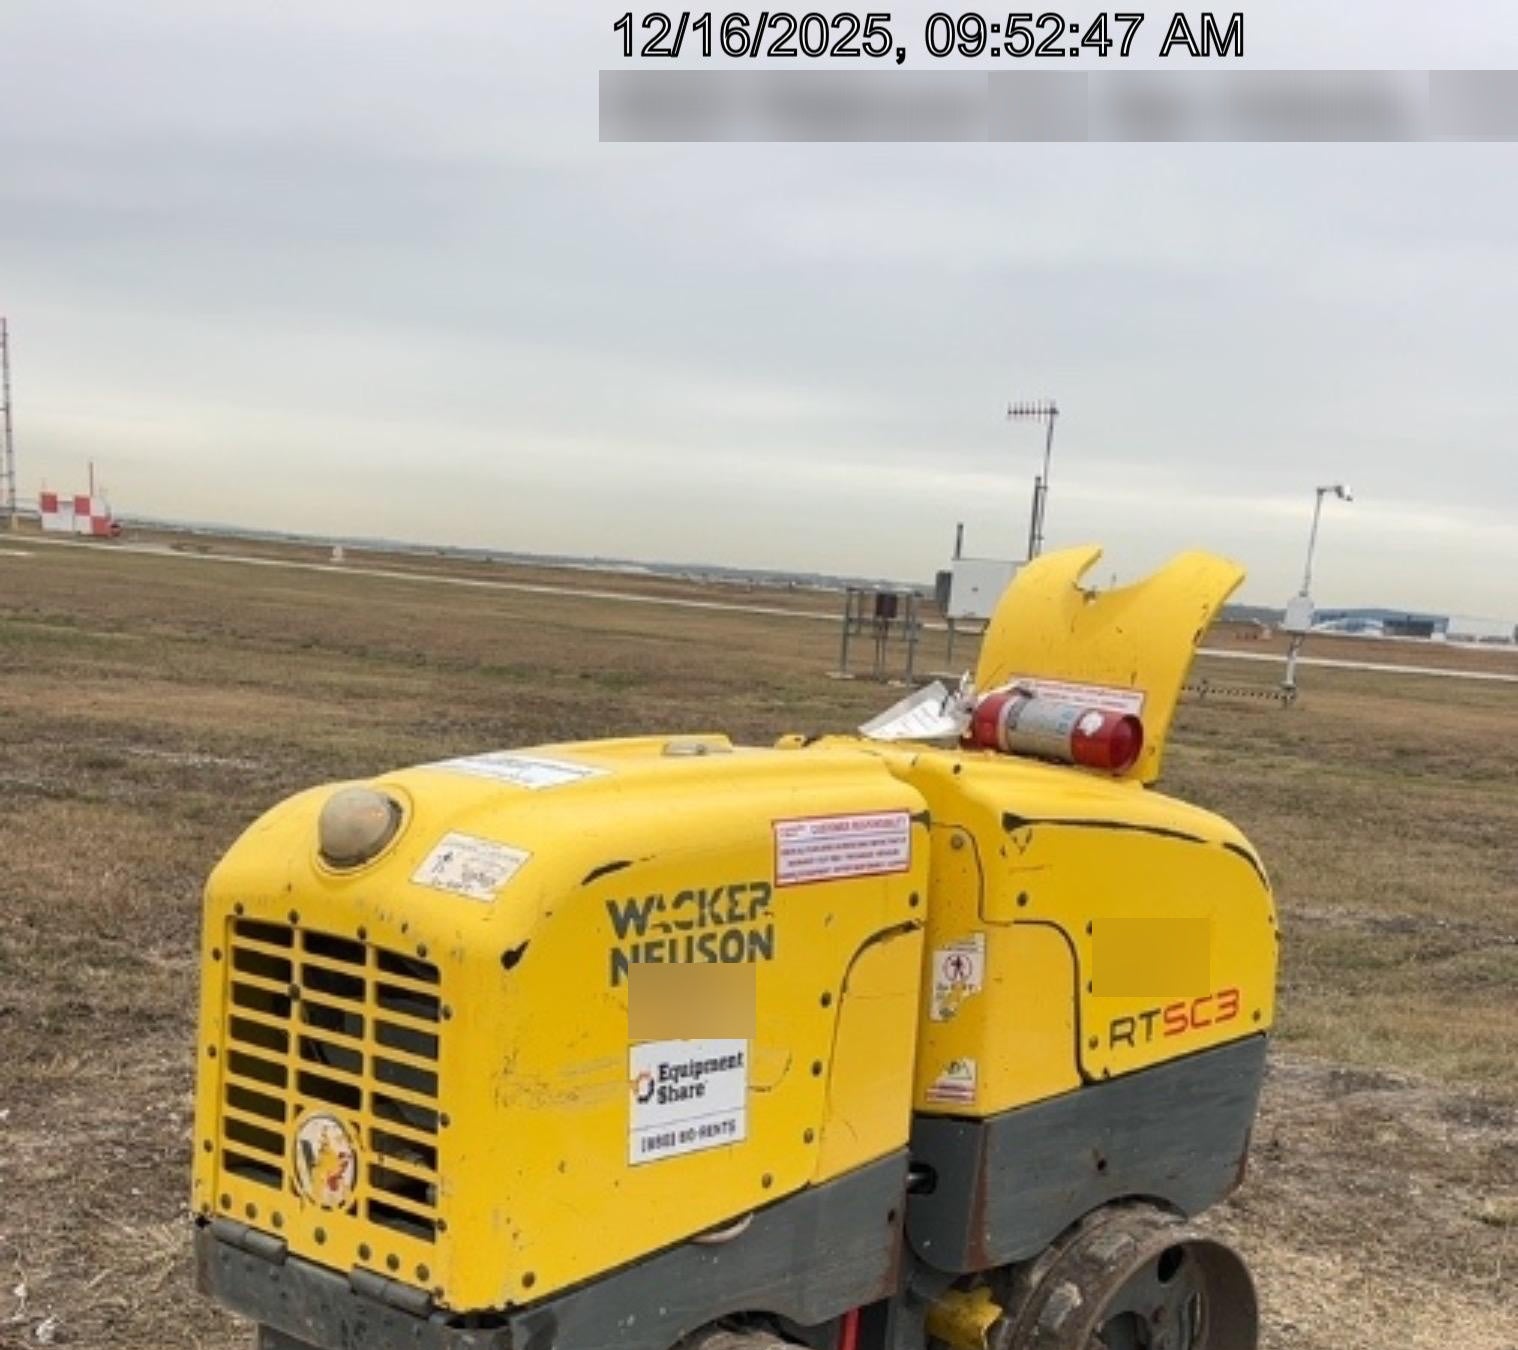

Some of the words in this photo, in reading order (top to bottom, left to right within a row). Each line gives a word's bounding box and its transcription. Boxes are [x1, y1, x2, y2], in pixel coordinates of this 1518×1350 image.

[606, 881, 773, 940] WACKER
[1109, 988, 1241, 1049] RTSC3
[657, 1051, 744, 1084] Equipment
[656, 1078, 706, 1105] Share
